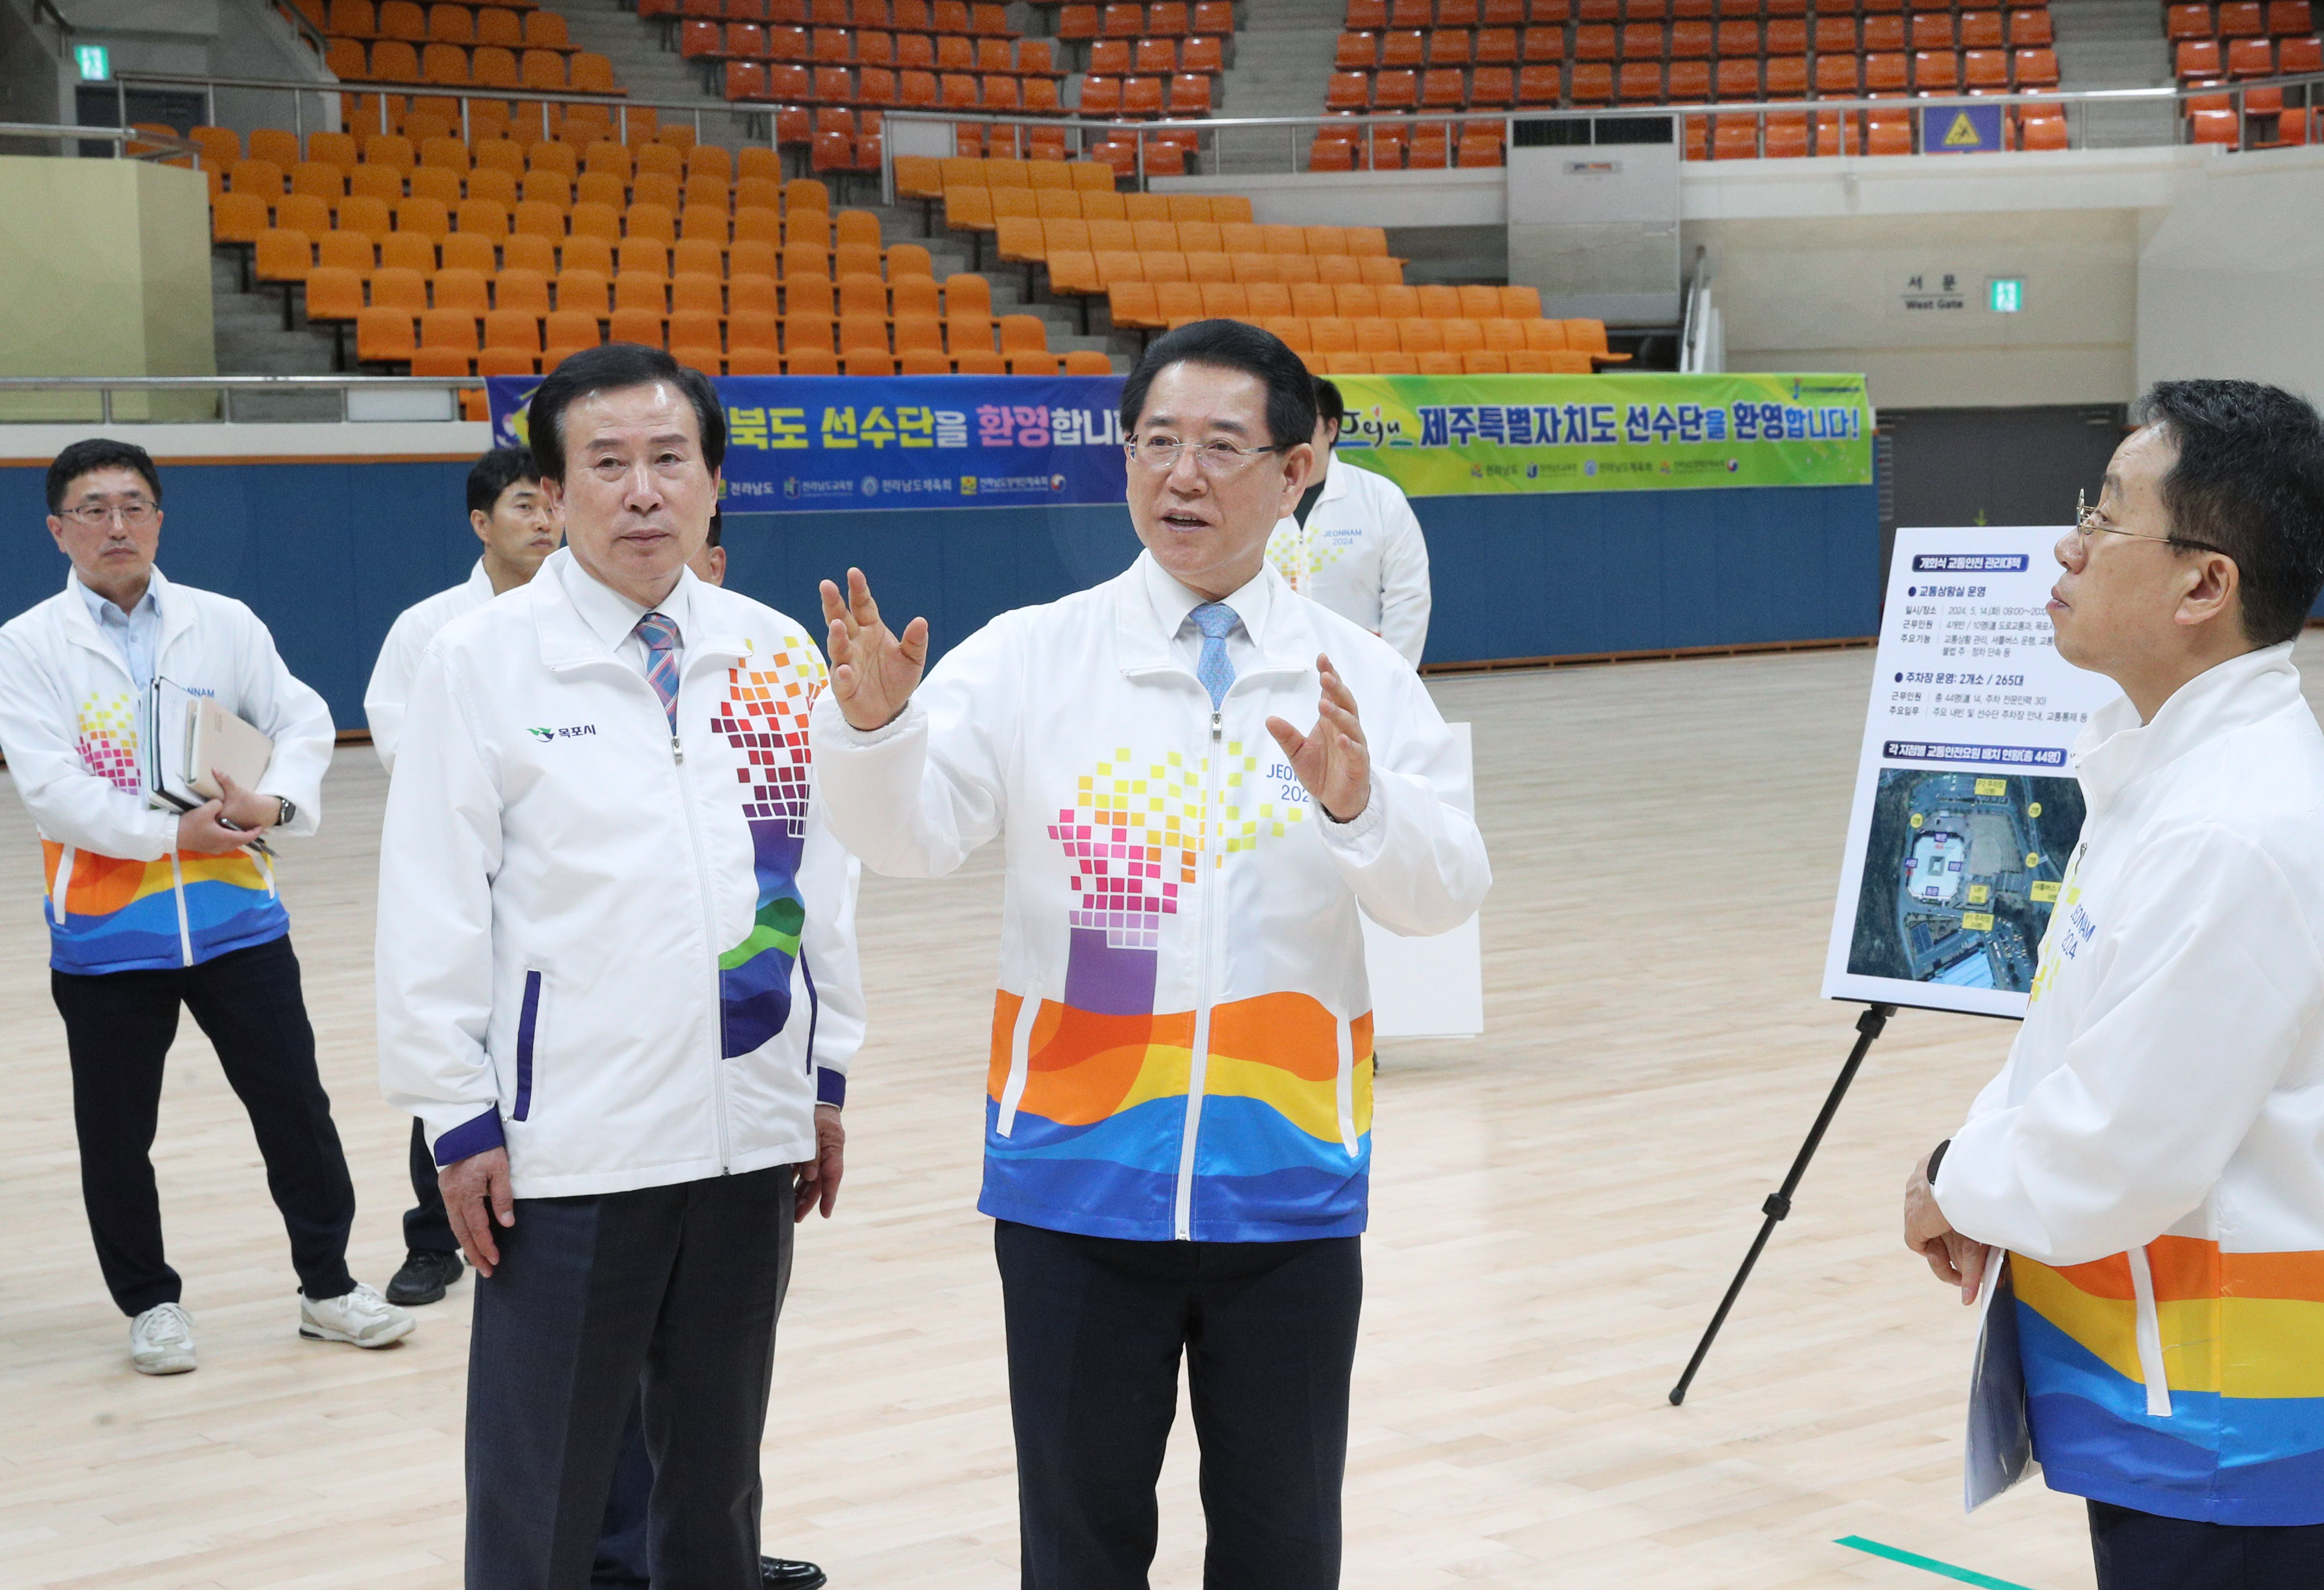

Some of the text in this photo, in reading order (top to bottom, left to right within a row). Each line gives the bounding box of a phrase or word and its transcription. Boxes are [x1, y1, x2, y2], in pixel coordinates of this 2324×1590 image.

[1905, 299, 1964, 310] West Gate
[725, 406, 809, 450] 북도
[821, 406, 968, 449] 선수단을
[1340, 406, 1400, 448] Jeju
[1418, 401, 1858, 445] 제주특별자치도 선수단을 환영합니다!
[1324, 529, 1362, 538] JEONNAM
[1919, 557, 2022, 569] 개회식 교통안전 관리대책
[1919, 586, 1986, 597] 교통상황실 운영
[1905, 606, 1936, 616] 일시/장소
[2003, 607, 2049, 616] 09:00~20:0
[1903, 620, 1933, 630] 근무인원
[1900, 634, 1931, 644] 주요기능
[1906, 672, 1933, 683] 주차장
[1936, 673, 1957, 684] 운영:
[1959, 674, 1984, 685] 2개소
[1996, 674, 2024, 686] 265대
[182, 687, 214, 698] NNAM
[1891, 691, 1922, 702] 근무인원
[1889, 706, 1919, 716] 주요임무
[1933, 707, 1947, 717] 주요
[1977, 709, 1999, 719] 선수단
[2002, 709, 2025, 720] 주차장
[558, 724, 596, 738] 목포시
[1889, 743, 1899, 755] 각
[1899, 744, 1926, 757] 지점별
[1926, 745, 1981, 760] 교통안전요원
[1981, 748, 2002, 761] 배치
[2034, 750, 2062, 764] 44명)
